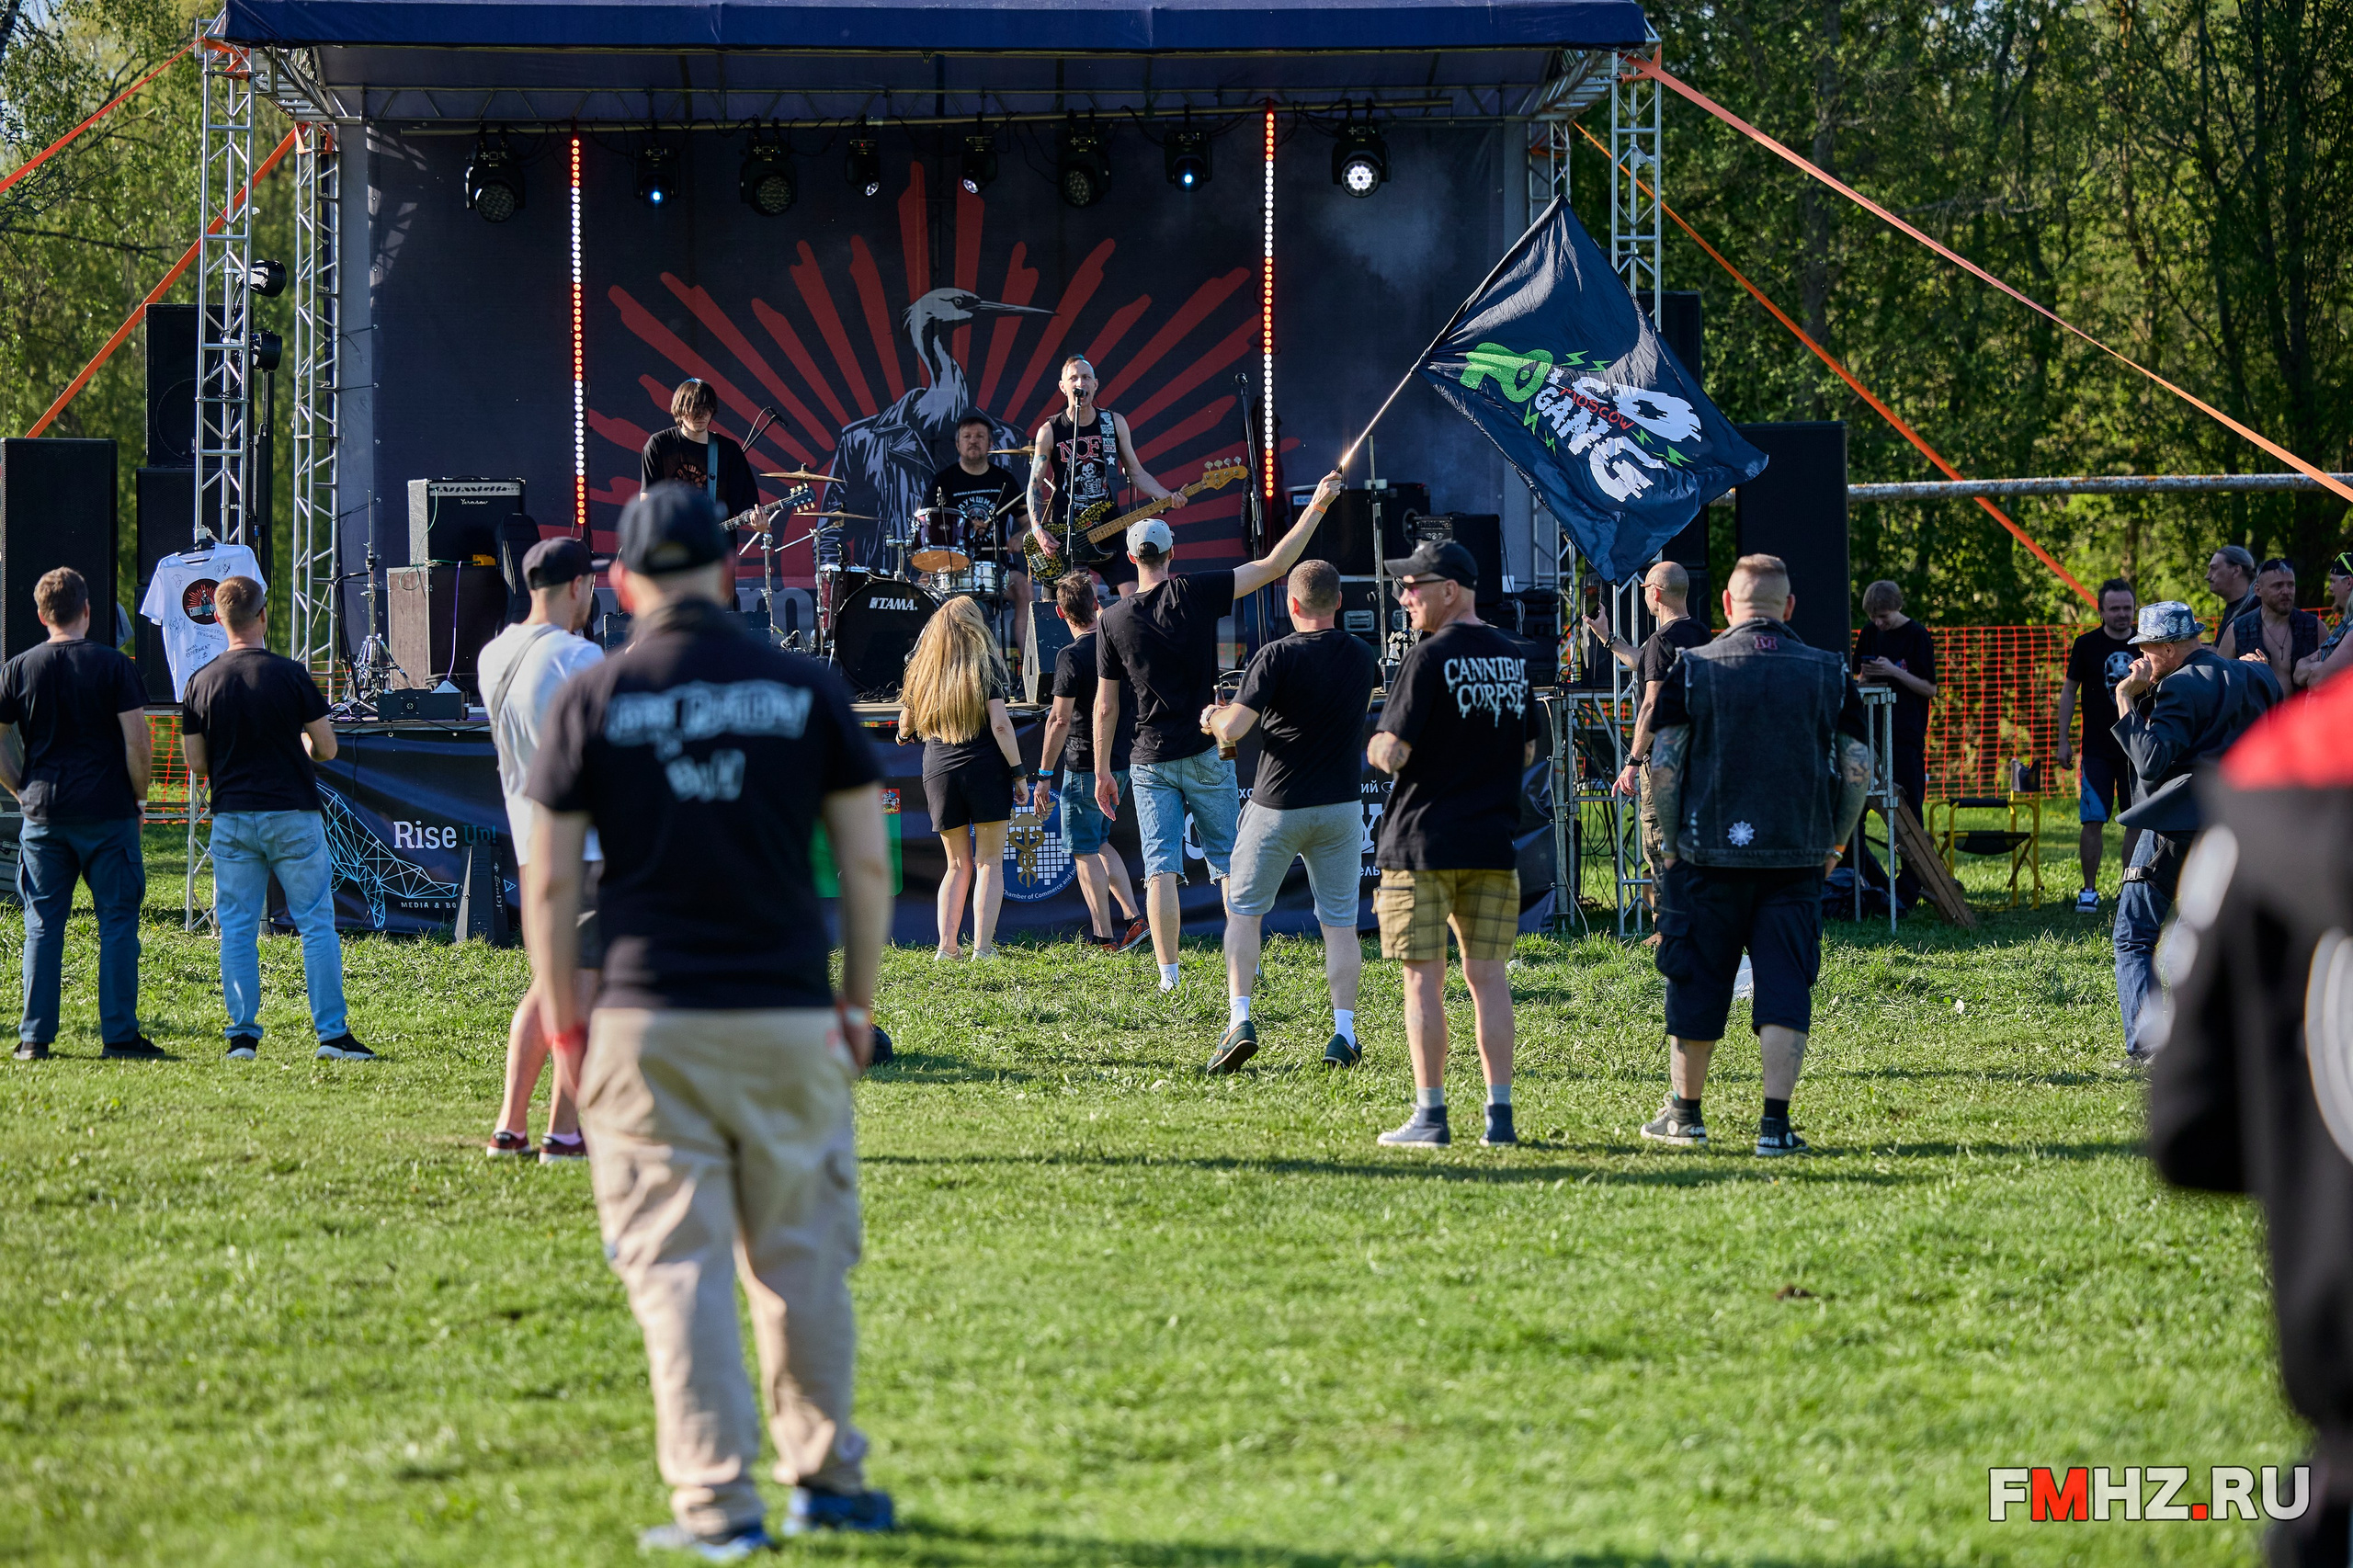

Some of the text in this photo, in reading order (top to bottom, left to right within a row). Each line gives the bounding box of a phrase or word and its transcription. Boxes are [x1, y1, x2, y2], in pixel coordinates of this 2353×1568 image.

[1559, 387, 1635, 430] MOSCOW
[1056, 436, 1102, 462] NOF
[1534, 386, 1666, 502] GANG
[1444, 656, 1529, 693] CANNIBAL
[1457, 682, 1526, 727] CORPSE
[393, 820, 457, 849] Rise
[1034, 883, 1063, 898] Commerce
[1063, 873, 1073, 885] and
